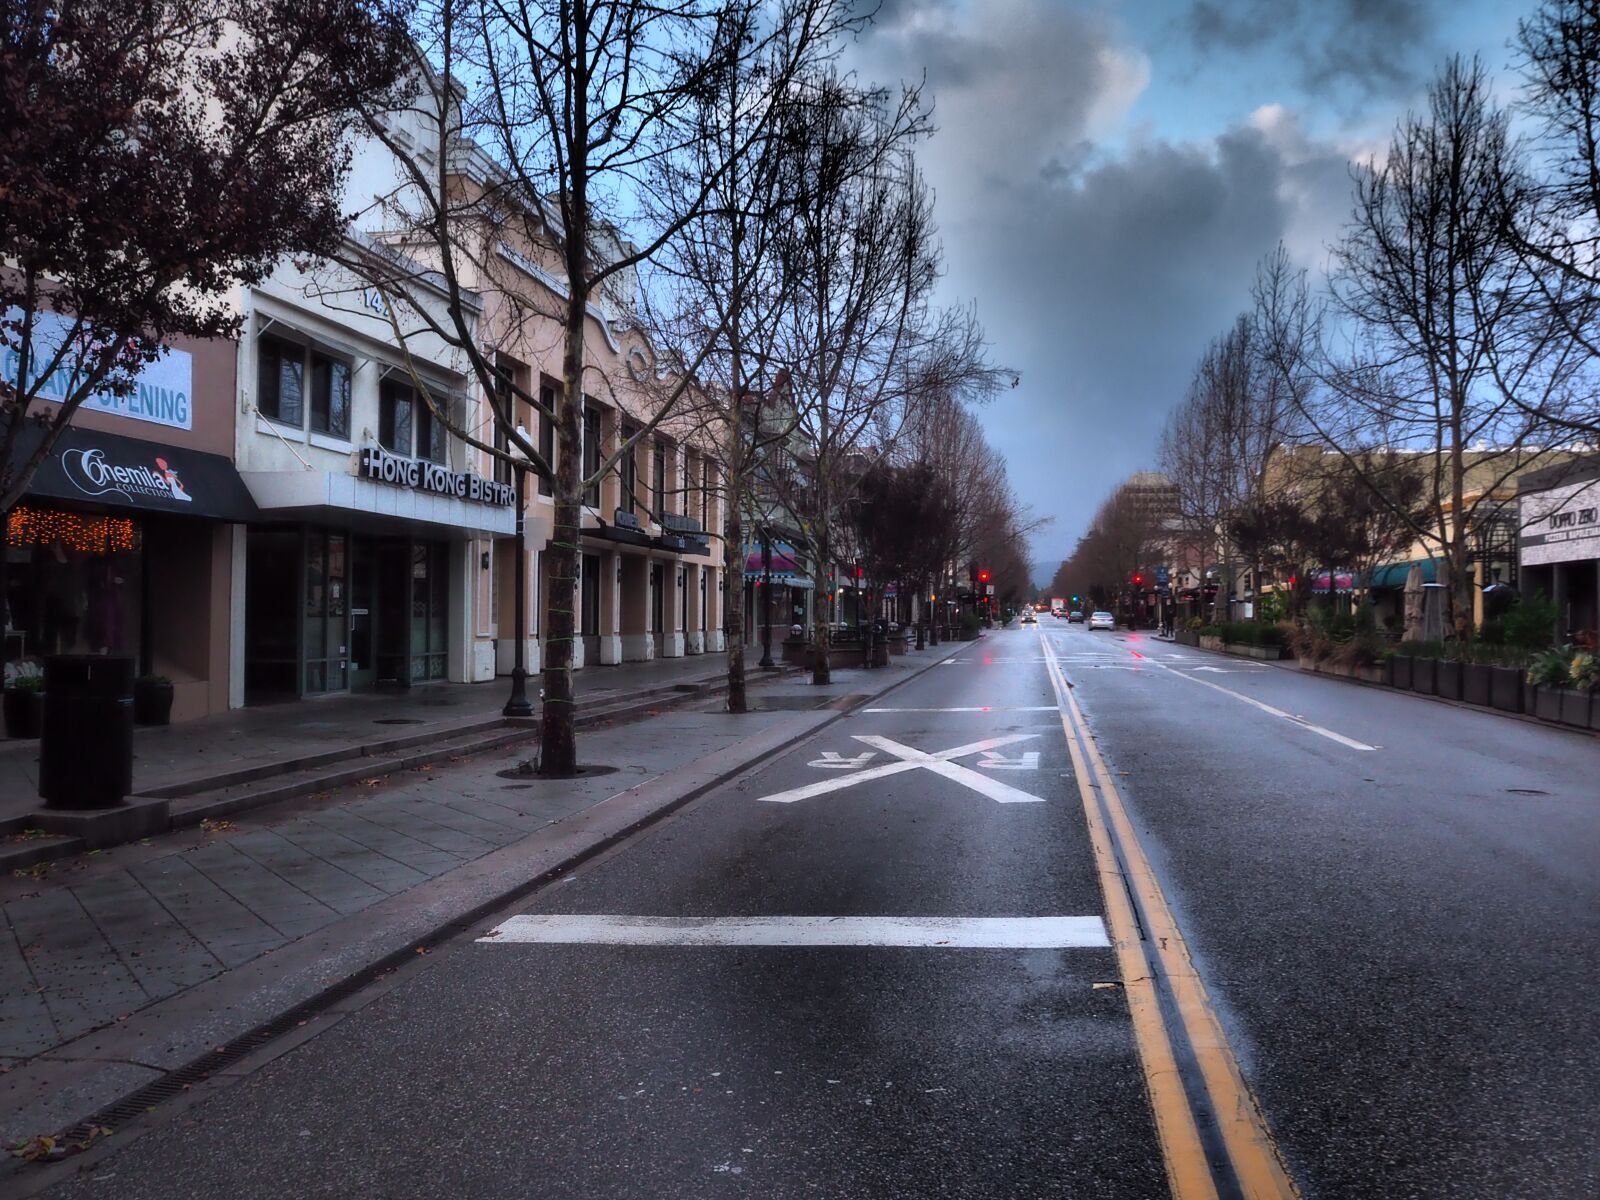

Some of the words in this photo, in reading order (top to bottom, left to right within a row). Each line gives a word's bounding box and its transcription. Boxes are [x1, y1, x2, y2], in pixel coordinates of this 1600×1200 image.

[4, 350, 93, 402] GAN
[67, 449, 169, 493] Chemila
[115, 482, 175, 499] COLLECTION
[368, 449, 419, 487] HONG
[423, 462, 466, 497] KONG
[469, 473, 517, 506] BISTRO
